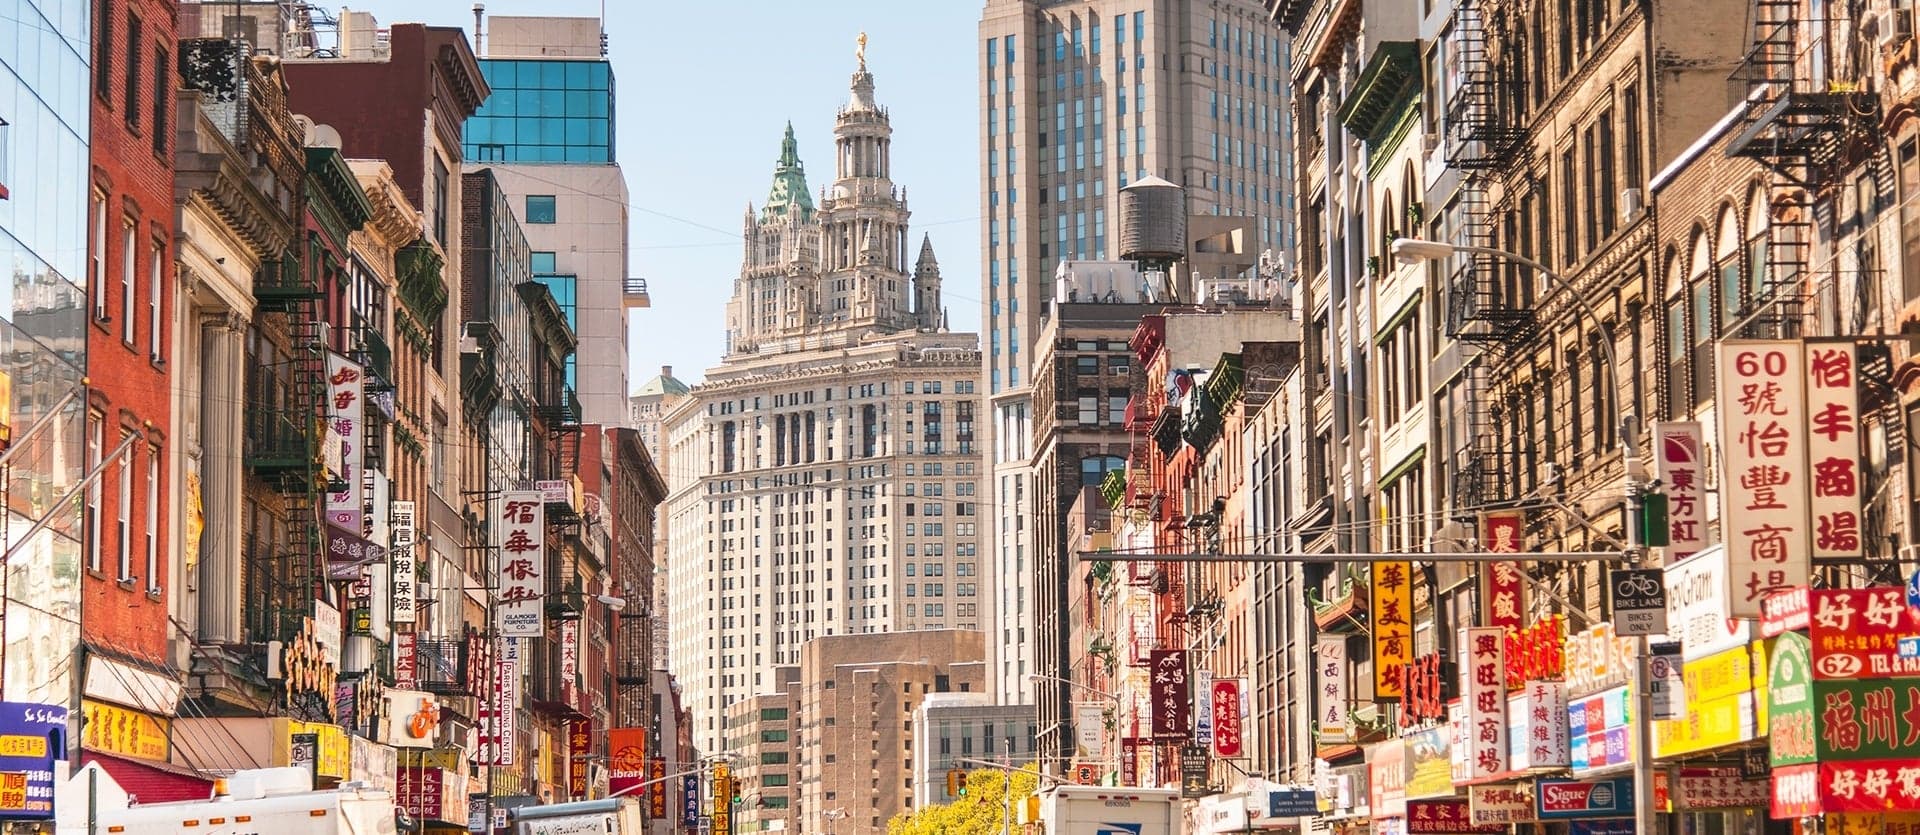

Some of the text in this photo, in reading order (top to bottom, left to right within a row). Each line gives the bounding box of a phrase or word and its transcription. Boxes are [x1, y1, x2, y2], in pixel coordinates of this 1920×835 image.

[1617, 597, 1662, 608] BIKE LANE
[1627, 613, 1653, 622] BIKES
[1629, 623, 1652, 632] ONLY
[1823, 656, 1854, 674] 62
[1869, 654, 1890, 673] TEL
[1892, 653, 1902, 673] &
[1324, 662, 1340, 724] 西餅屋
[503, 664, 512, 762] PARIS WEDDING CENTER
[1474, 634, 1501, 773] 興旺旺商場
[1533, 685, 1552, 763] 手機維修
[609, 768, 643, 779] Library
[1546, 786, 1585, 805] Sigue
